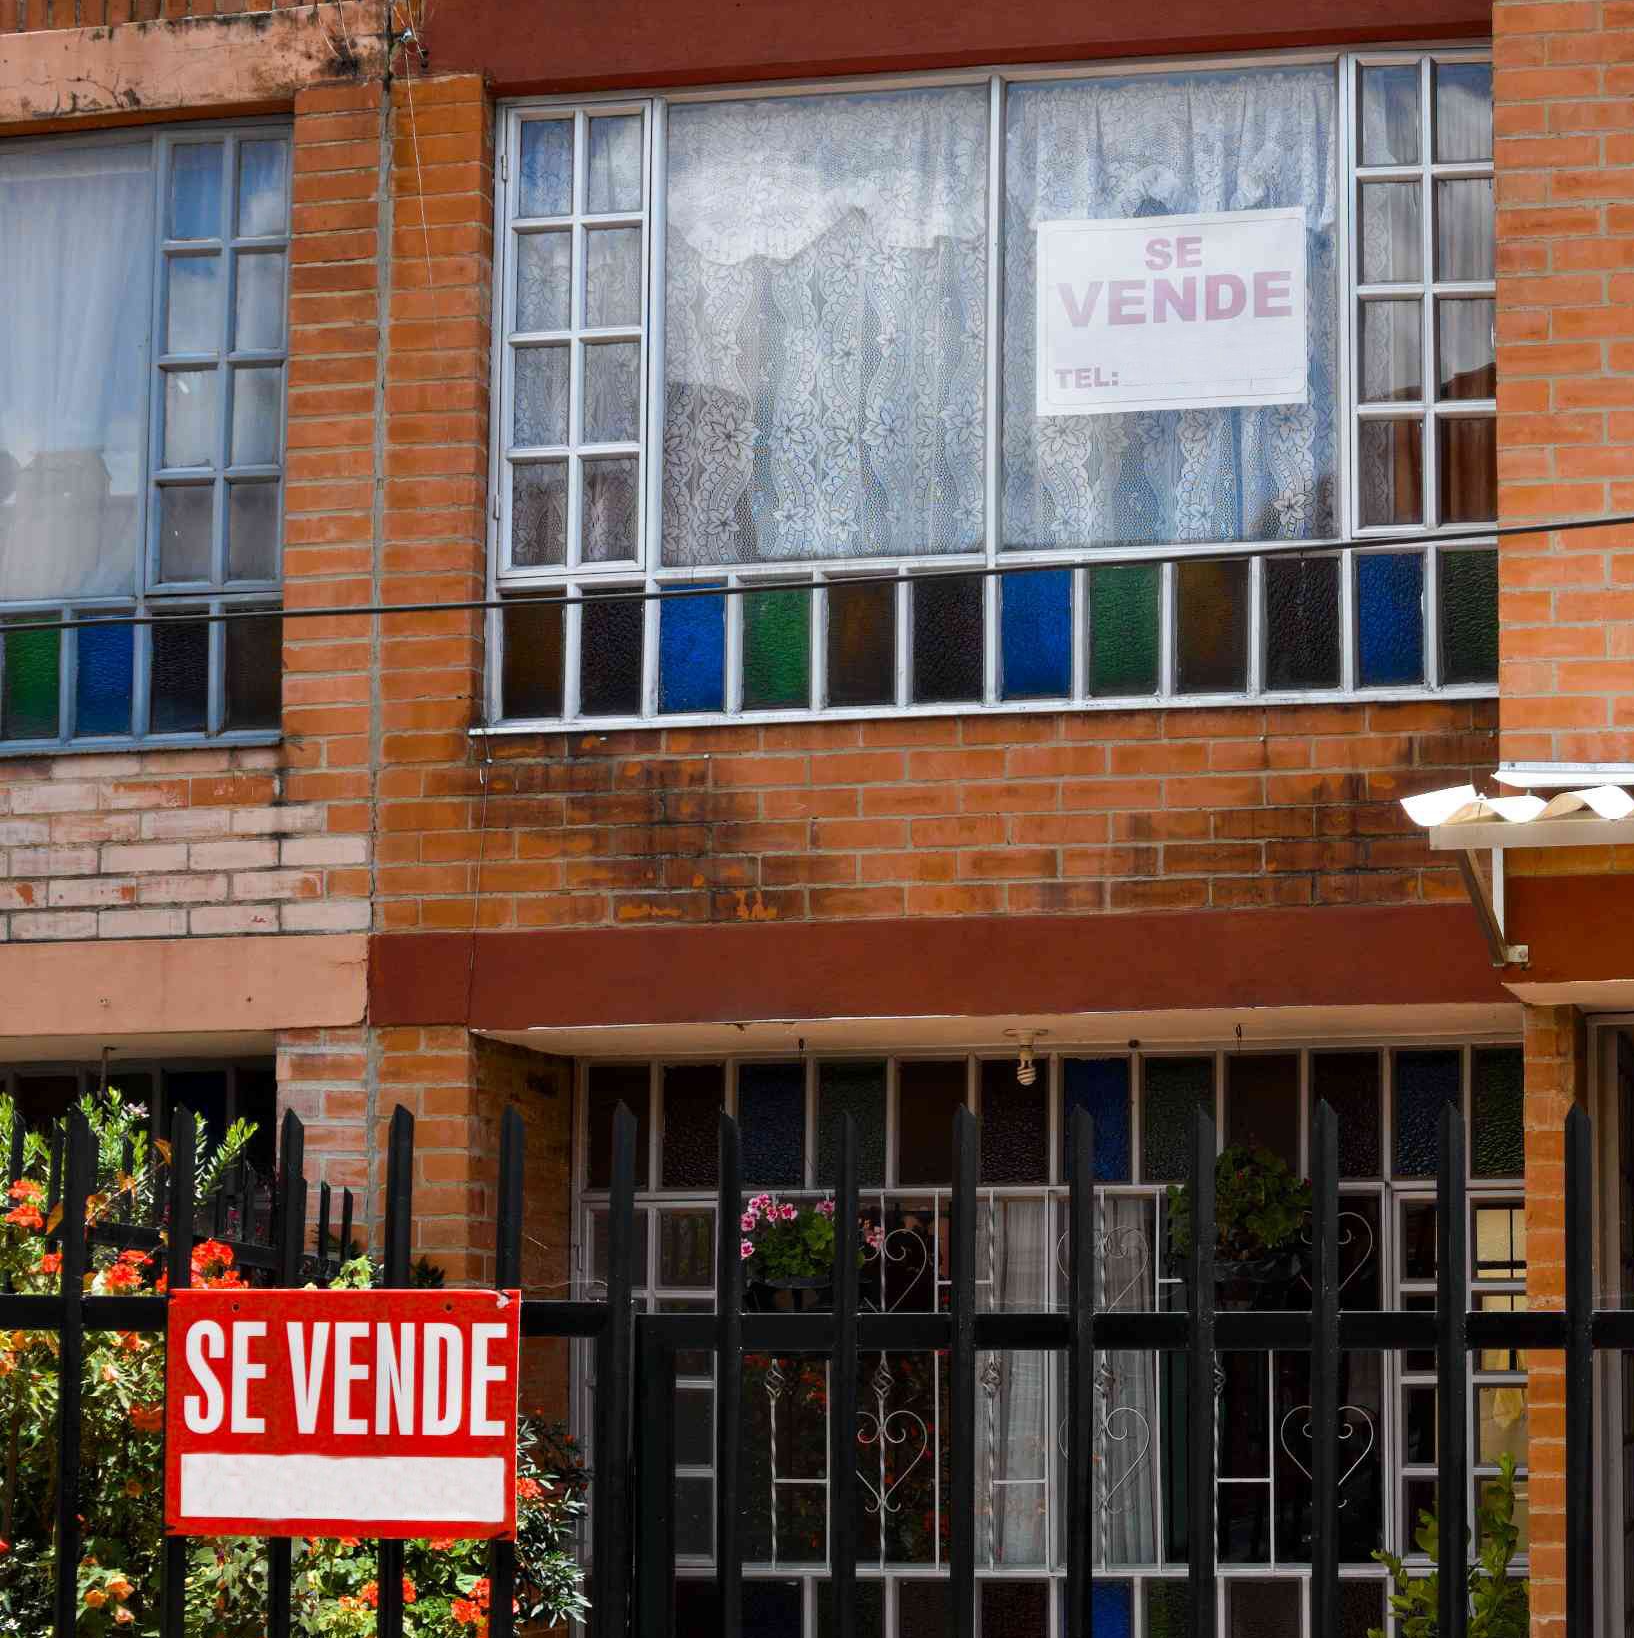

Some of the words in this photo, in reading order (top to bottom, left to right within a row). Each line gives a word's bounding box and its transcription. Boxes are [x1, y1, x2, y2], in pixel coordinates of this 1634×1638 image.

[1145, 236, 1203, 271] SE
[1056, 271, 1293, 327] VENDE
[1054, 364, 1119, 390] TEL:
[183, 1319, 267, 1434] SE
[286, 1321, 508, 1436] VENDE
